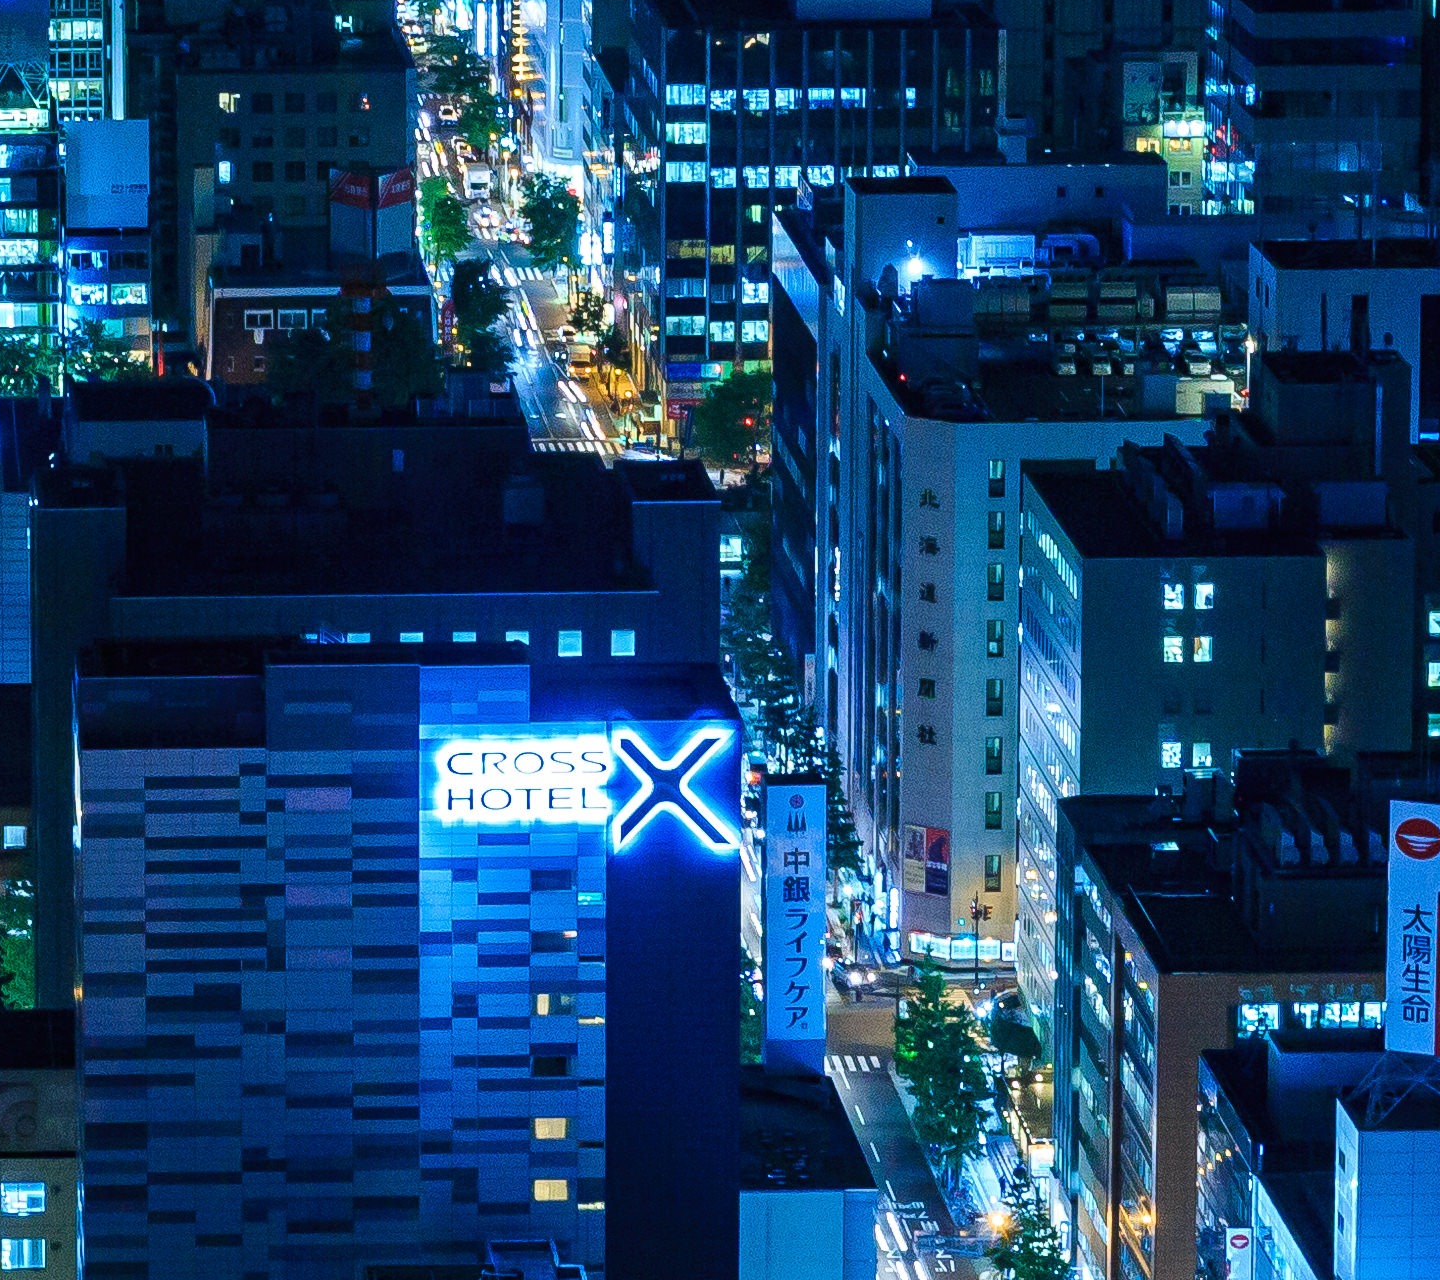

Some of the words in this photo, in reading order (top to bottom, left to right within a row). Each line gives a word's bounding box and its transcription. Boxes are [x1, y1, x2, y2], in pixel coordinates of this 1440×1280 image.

[446, 750, 607, 775] CROSS
[446, 787, 607, 810] HOTEL
[782, 847, 810, 1030] 中銀ライフケア
[1401, 904, 1433, 1024] 太陽生命
